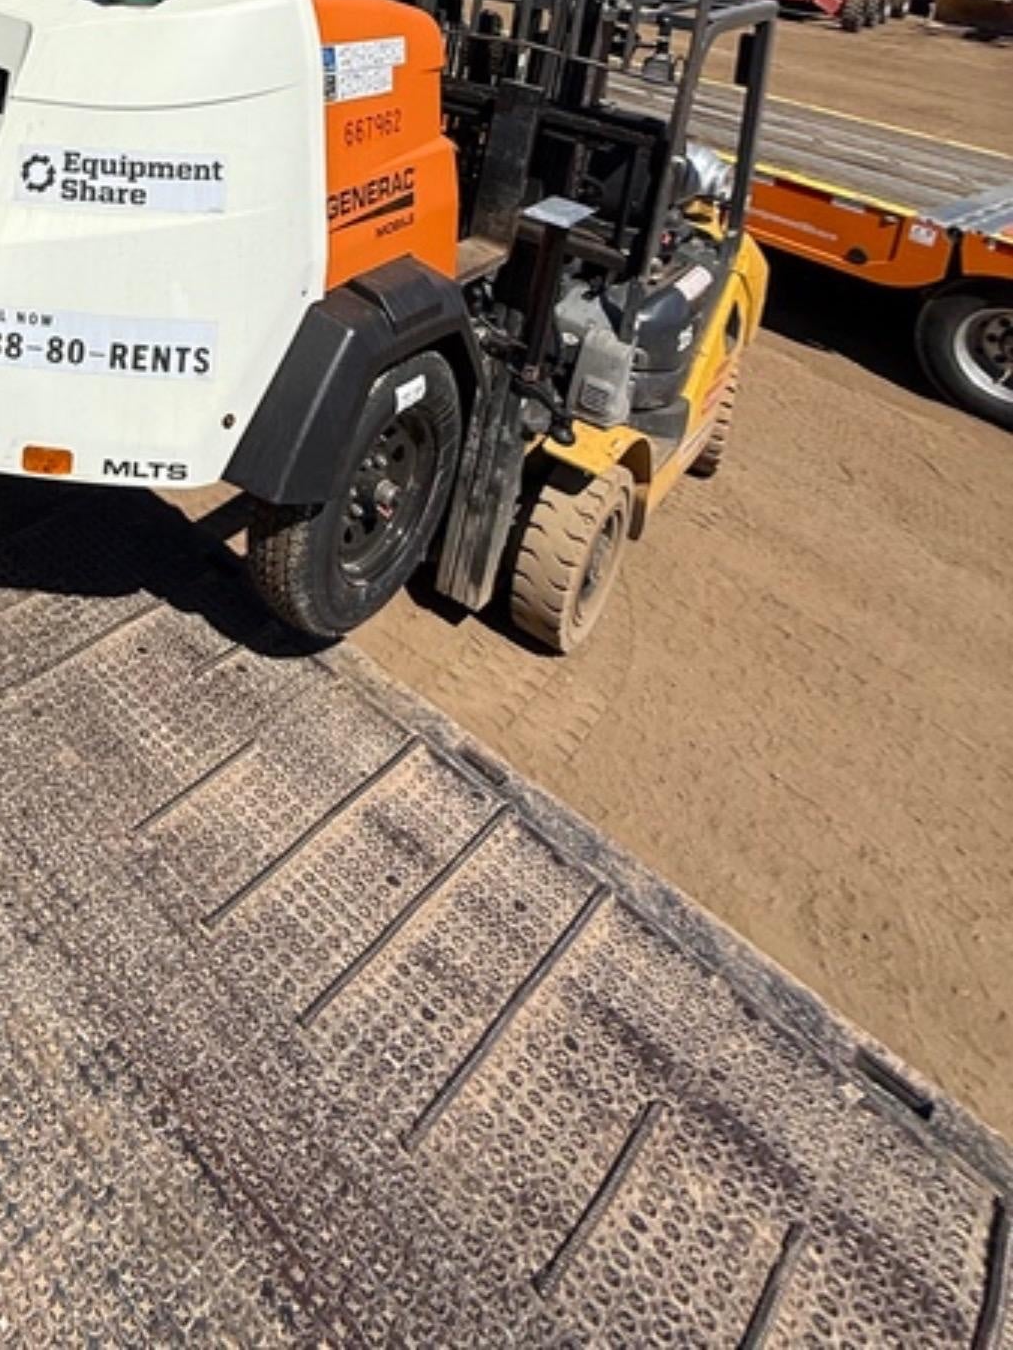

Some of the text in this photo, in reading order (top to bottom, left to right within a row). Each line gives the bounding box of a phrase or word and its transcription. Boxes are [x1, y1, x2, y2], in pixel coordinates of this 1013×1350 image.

[344, 107, 402, 148] 667962
[62, 151, 224, 182] Equipment
[61, 180, 147, 206] Share
[328, 167, 415, 220] GENERAC
[16, 310, 54, 327] NOW
[103, 458, 188, 481] MLTS
